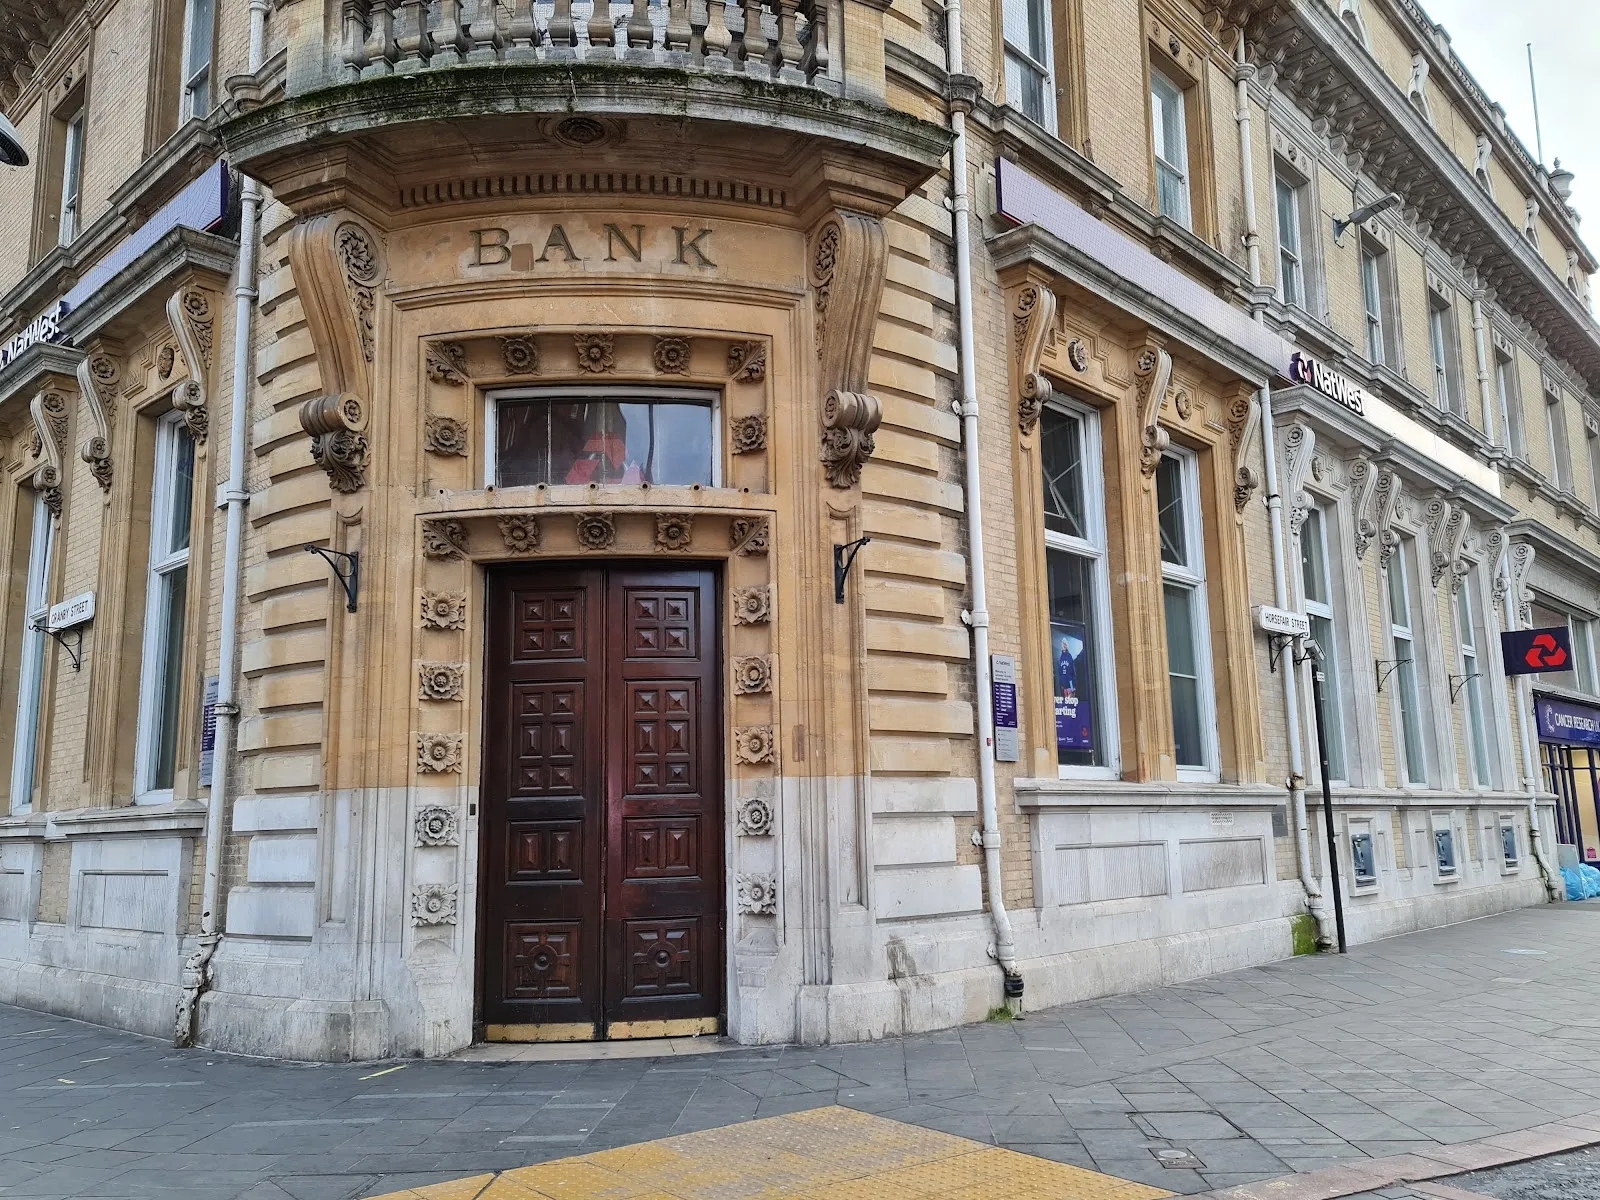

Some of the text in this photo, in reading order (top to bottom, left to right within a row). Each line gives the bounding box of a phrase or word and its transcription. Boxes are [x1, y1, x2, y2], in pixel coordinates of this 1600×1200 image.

[467, 223, 718, 269] BANK
[7, 300, 62, 364] NatWest
[1312, 359, 1365, 417] NatWest
[51, 600, 89, 625] GRANBY STREET
[1265, 612, 1308, 631] HORSEFAIR STREET
[1065, 697, 1079, 707] stop
[1554, 712, 1573, 728] CANCER
[1573, 715, 1594, 731] RESEARCH
